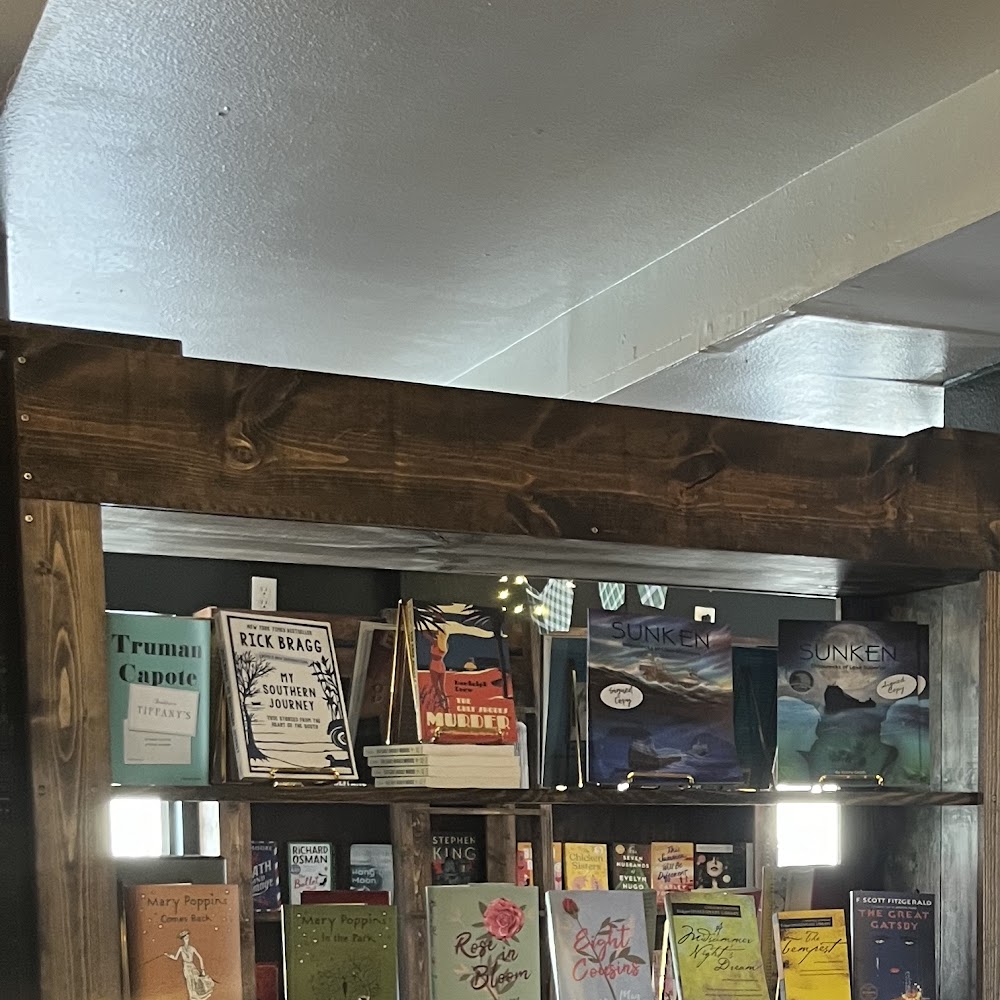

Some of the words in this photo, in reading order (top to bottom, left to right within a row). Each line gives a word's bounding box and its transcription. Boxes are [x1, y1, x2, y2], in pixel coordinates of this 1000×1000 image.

[612, 621, 710, 649] SUNKEN
[112, 634, 202, 659] Truman
[239, 632, 274, 649] RICK
[278, 635, 322, 653] BRAGG
[800, 643, 897, 662] SUNKEN
[119, 663, 198, 686] Capote
[280, 673, 293, 683] MY
[262, 684, 317, 698] SOUTHERN
[269, 698, 315, 711] JOURNEY
[137, 706, 191, 720] TIFFANY'S
[426, 712, 511, 730] MURDER
[432, 836, 476, 844] STEPHEN
[292, 846, 328, 854] RICHARD
[433, 847, 476, 860] KING
[569, 853, 603, 861] Chicken
[292, 855, 327, 864] OSMAN
[147, 898, 181, 915] Mary
[184, 893, 227, 911] Poppins
[888, 898, 932, 906] FITZGERALD
[161, 915, 188, 923] Comes
[191, 913, 213, 922] Back
[858, 909, 882, 917] THE
[888, 910, 930, 920] GREAT
[301, 916, 336, 933] Mary
[340, 913, 387, 930] Poppins
[870, 920, 919, 931] GATSBY
[334, 933, 348, 942] the
[352, 933, 377, 943] Park
[574, 924, 630, 962] Eight
[455, 931, 497, 959] Rose
[501, 948, 518, 962] in
[572, 959, 640, 982] Cousins
[714, 958, 763, 971] Dream
[470, 964, 532, 990] Bloom
